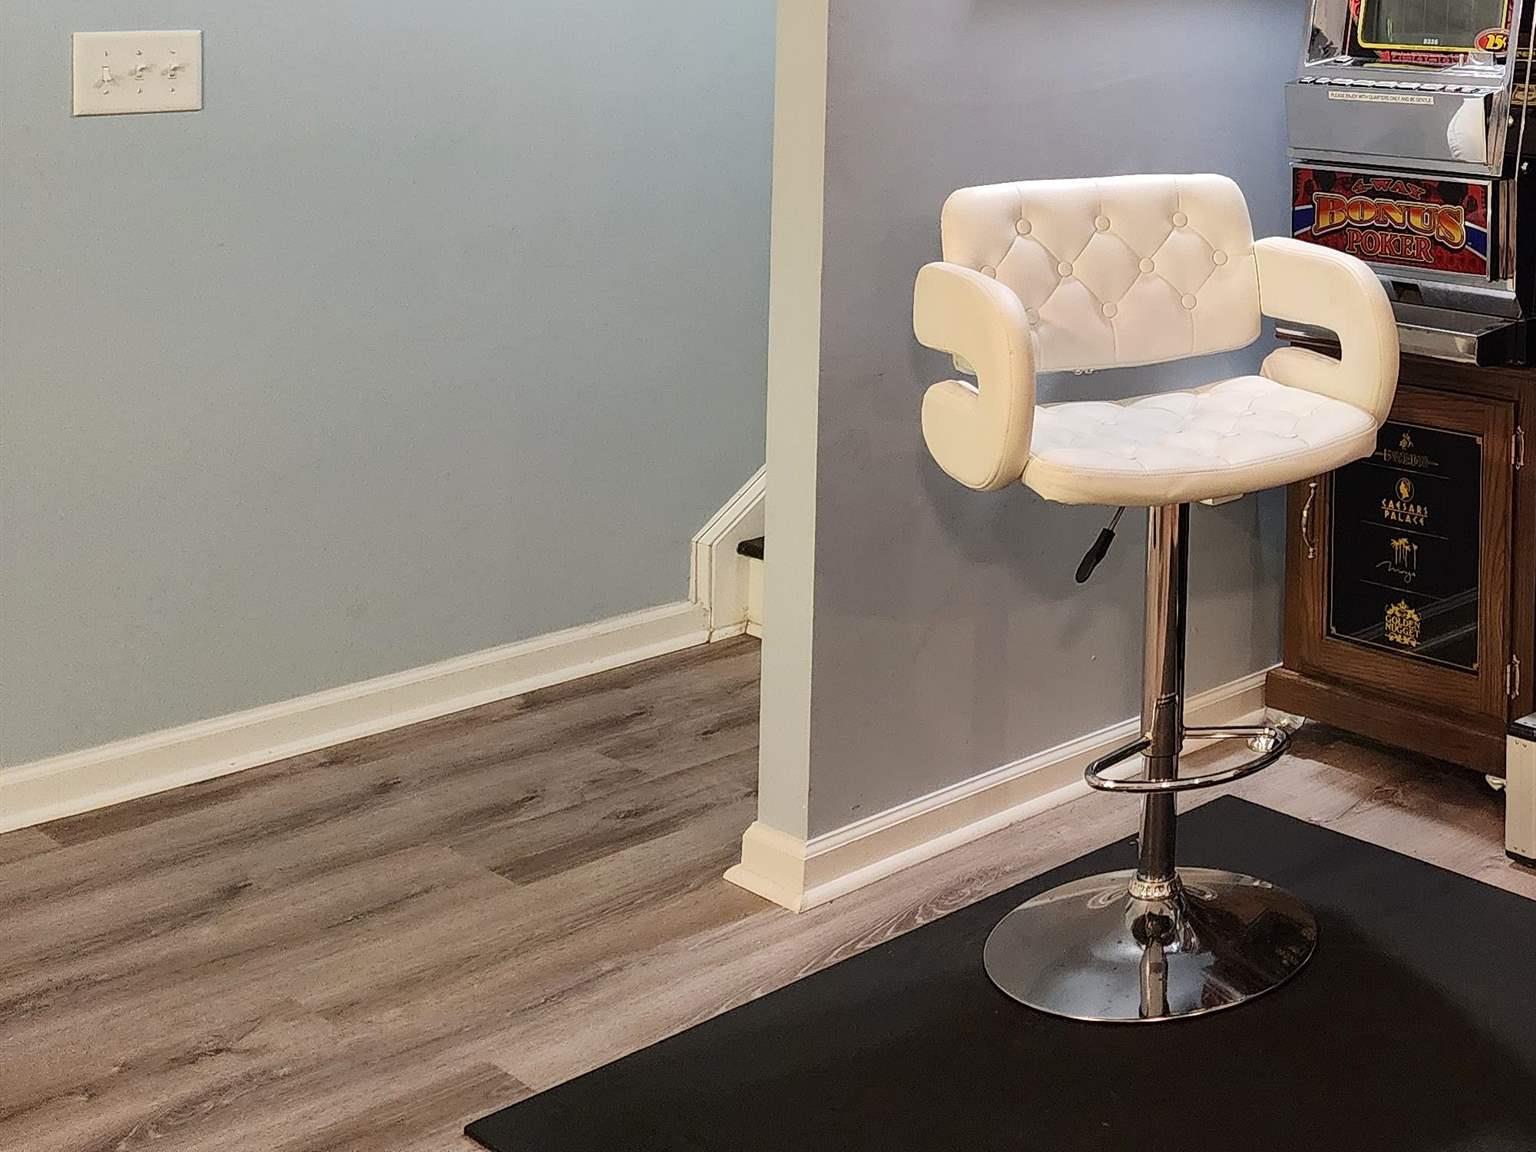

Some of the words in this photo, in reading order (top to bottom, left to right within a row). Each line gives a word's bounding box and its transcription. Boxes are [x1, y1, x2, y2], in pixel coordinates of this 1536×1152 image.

[1352, 178, 1427, 200] 4-WAY
[1312, 192, 1466, 248] BONUS
[1346, 228, 1434, 264] POKER
[1381, 498, 1429, 516] CAESARS
[1384, 510, 1425, 526] PALACE
[1385, 614, 1421, 630] GOLDEN
[1385, 622, 1420, 638] NUGGET
